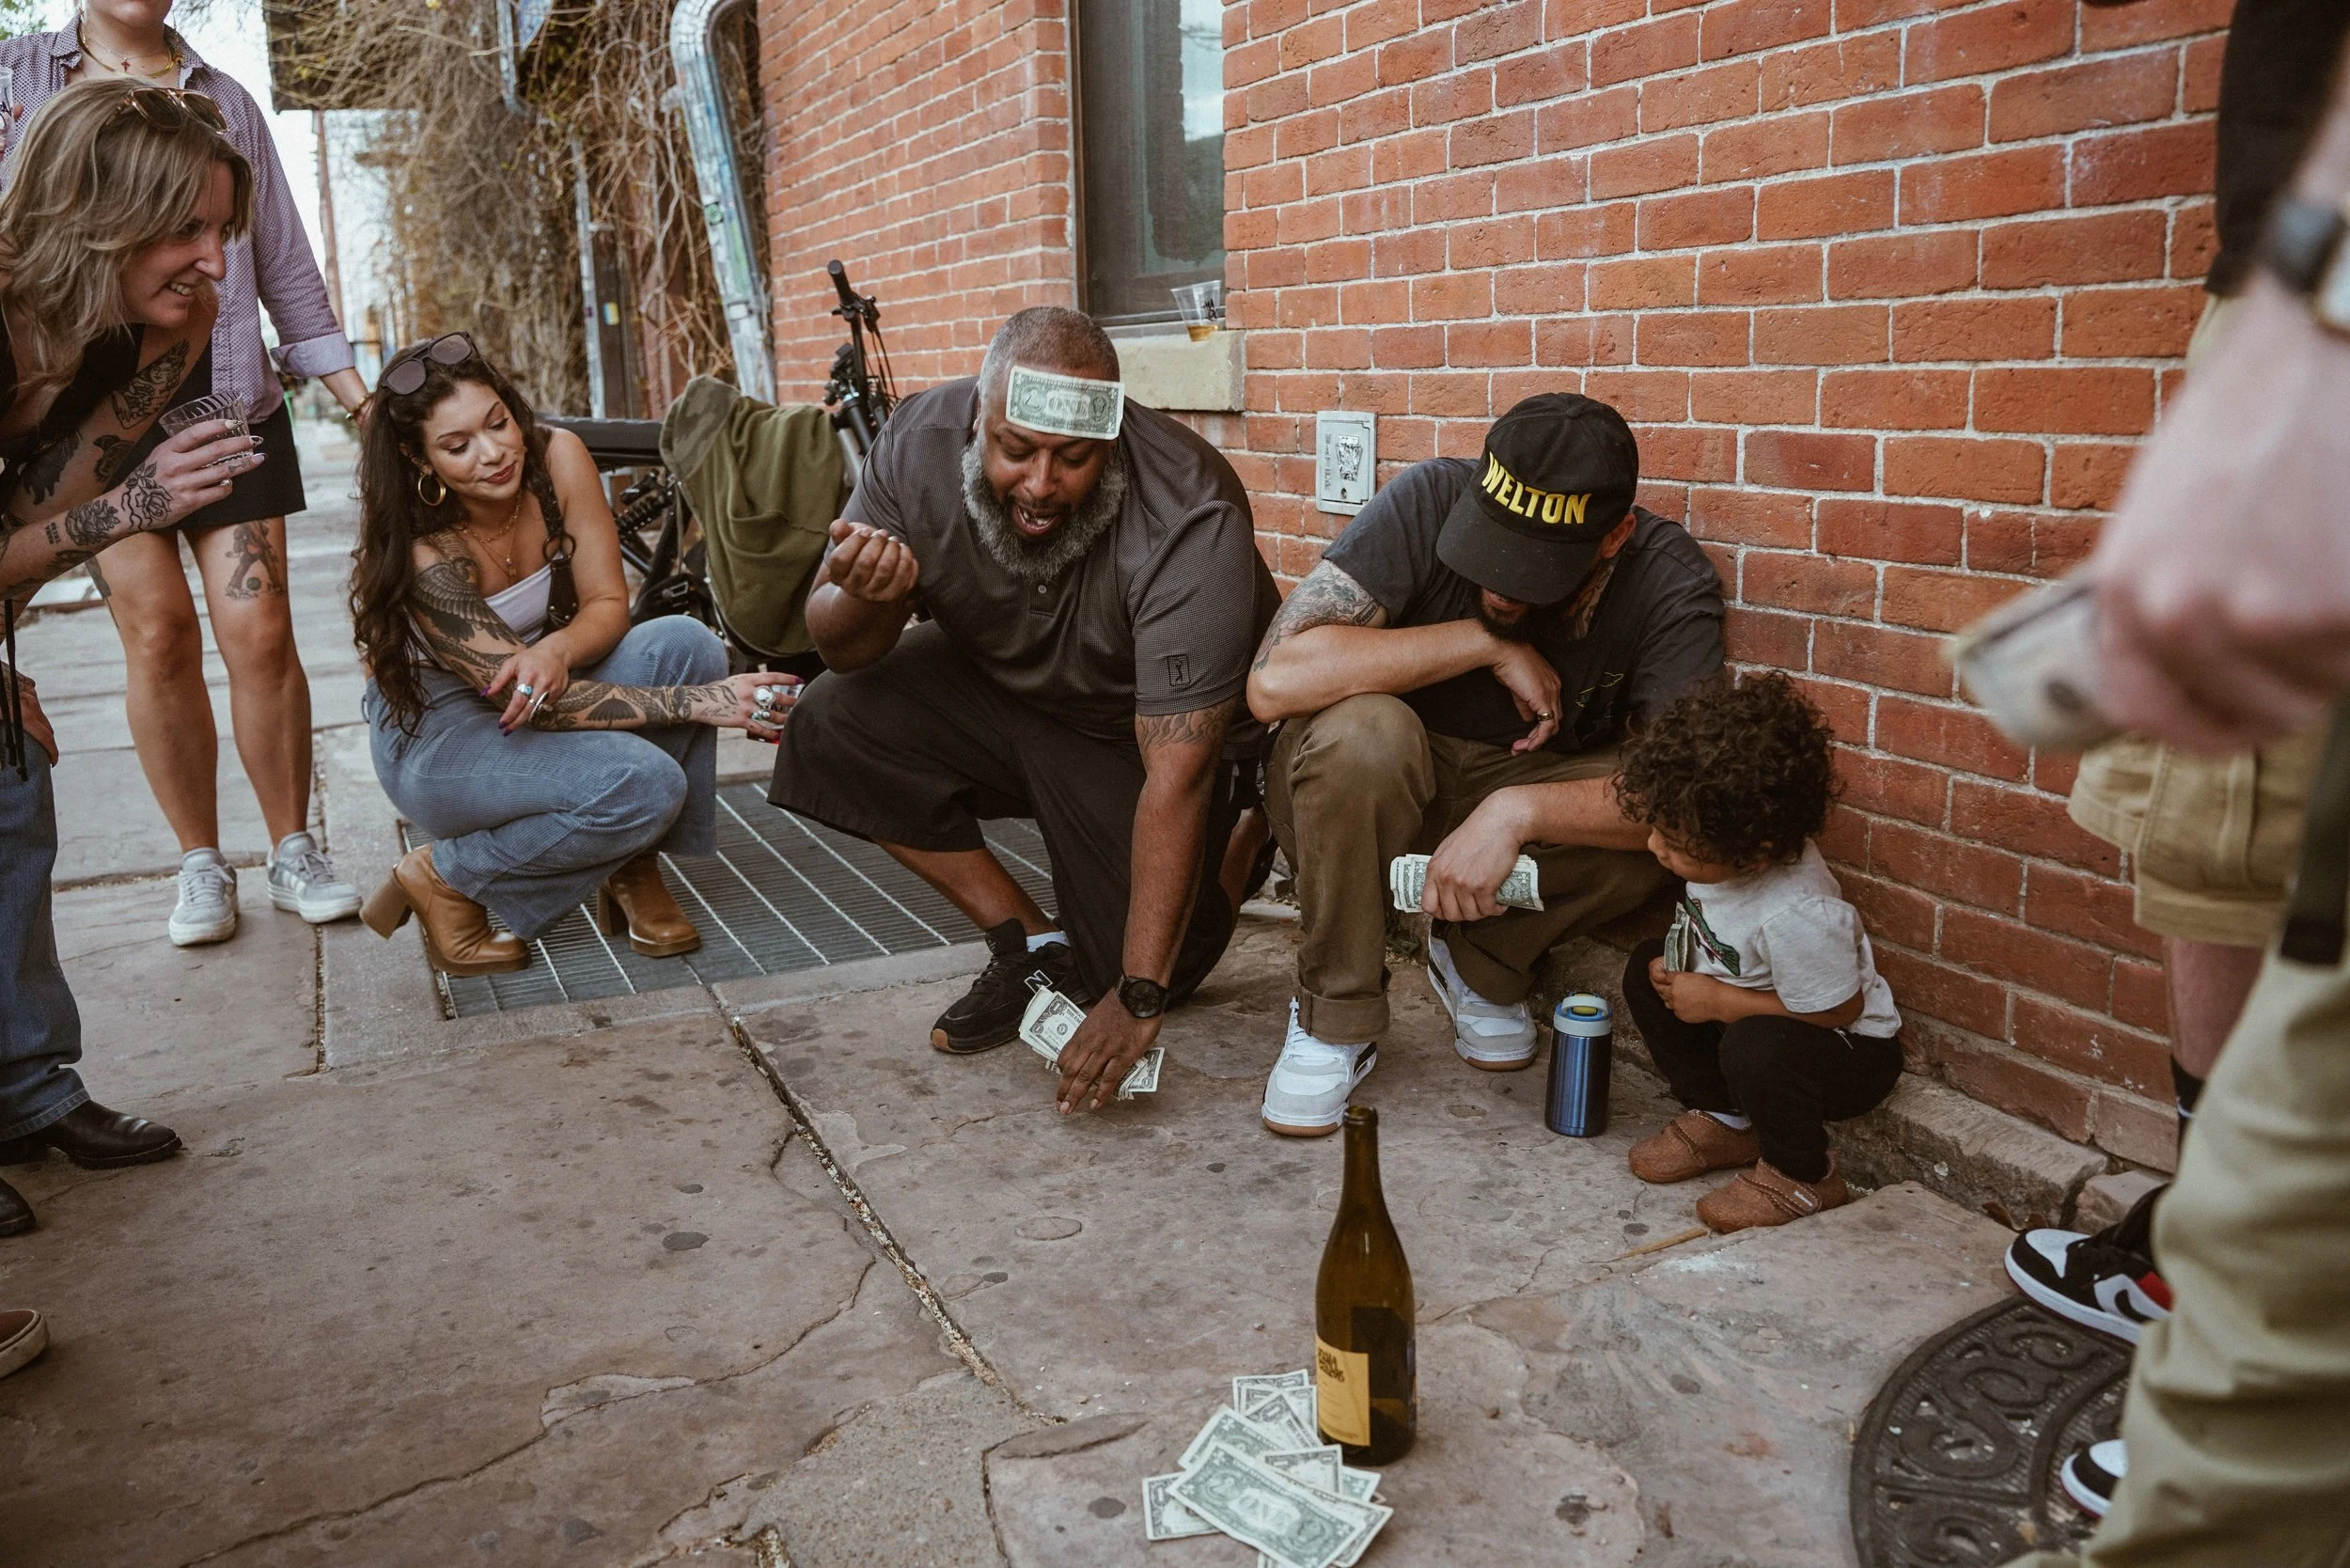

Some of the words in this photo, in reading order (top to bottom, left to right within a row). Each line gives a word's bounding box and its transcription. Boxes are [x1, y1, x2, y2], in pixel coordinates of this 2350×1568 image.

[1048, 396, 1089, 418] ONE
[1481, 451, 1591, 525] WELTON
[1024, 969, 1053, 994] N
